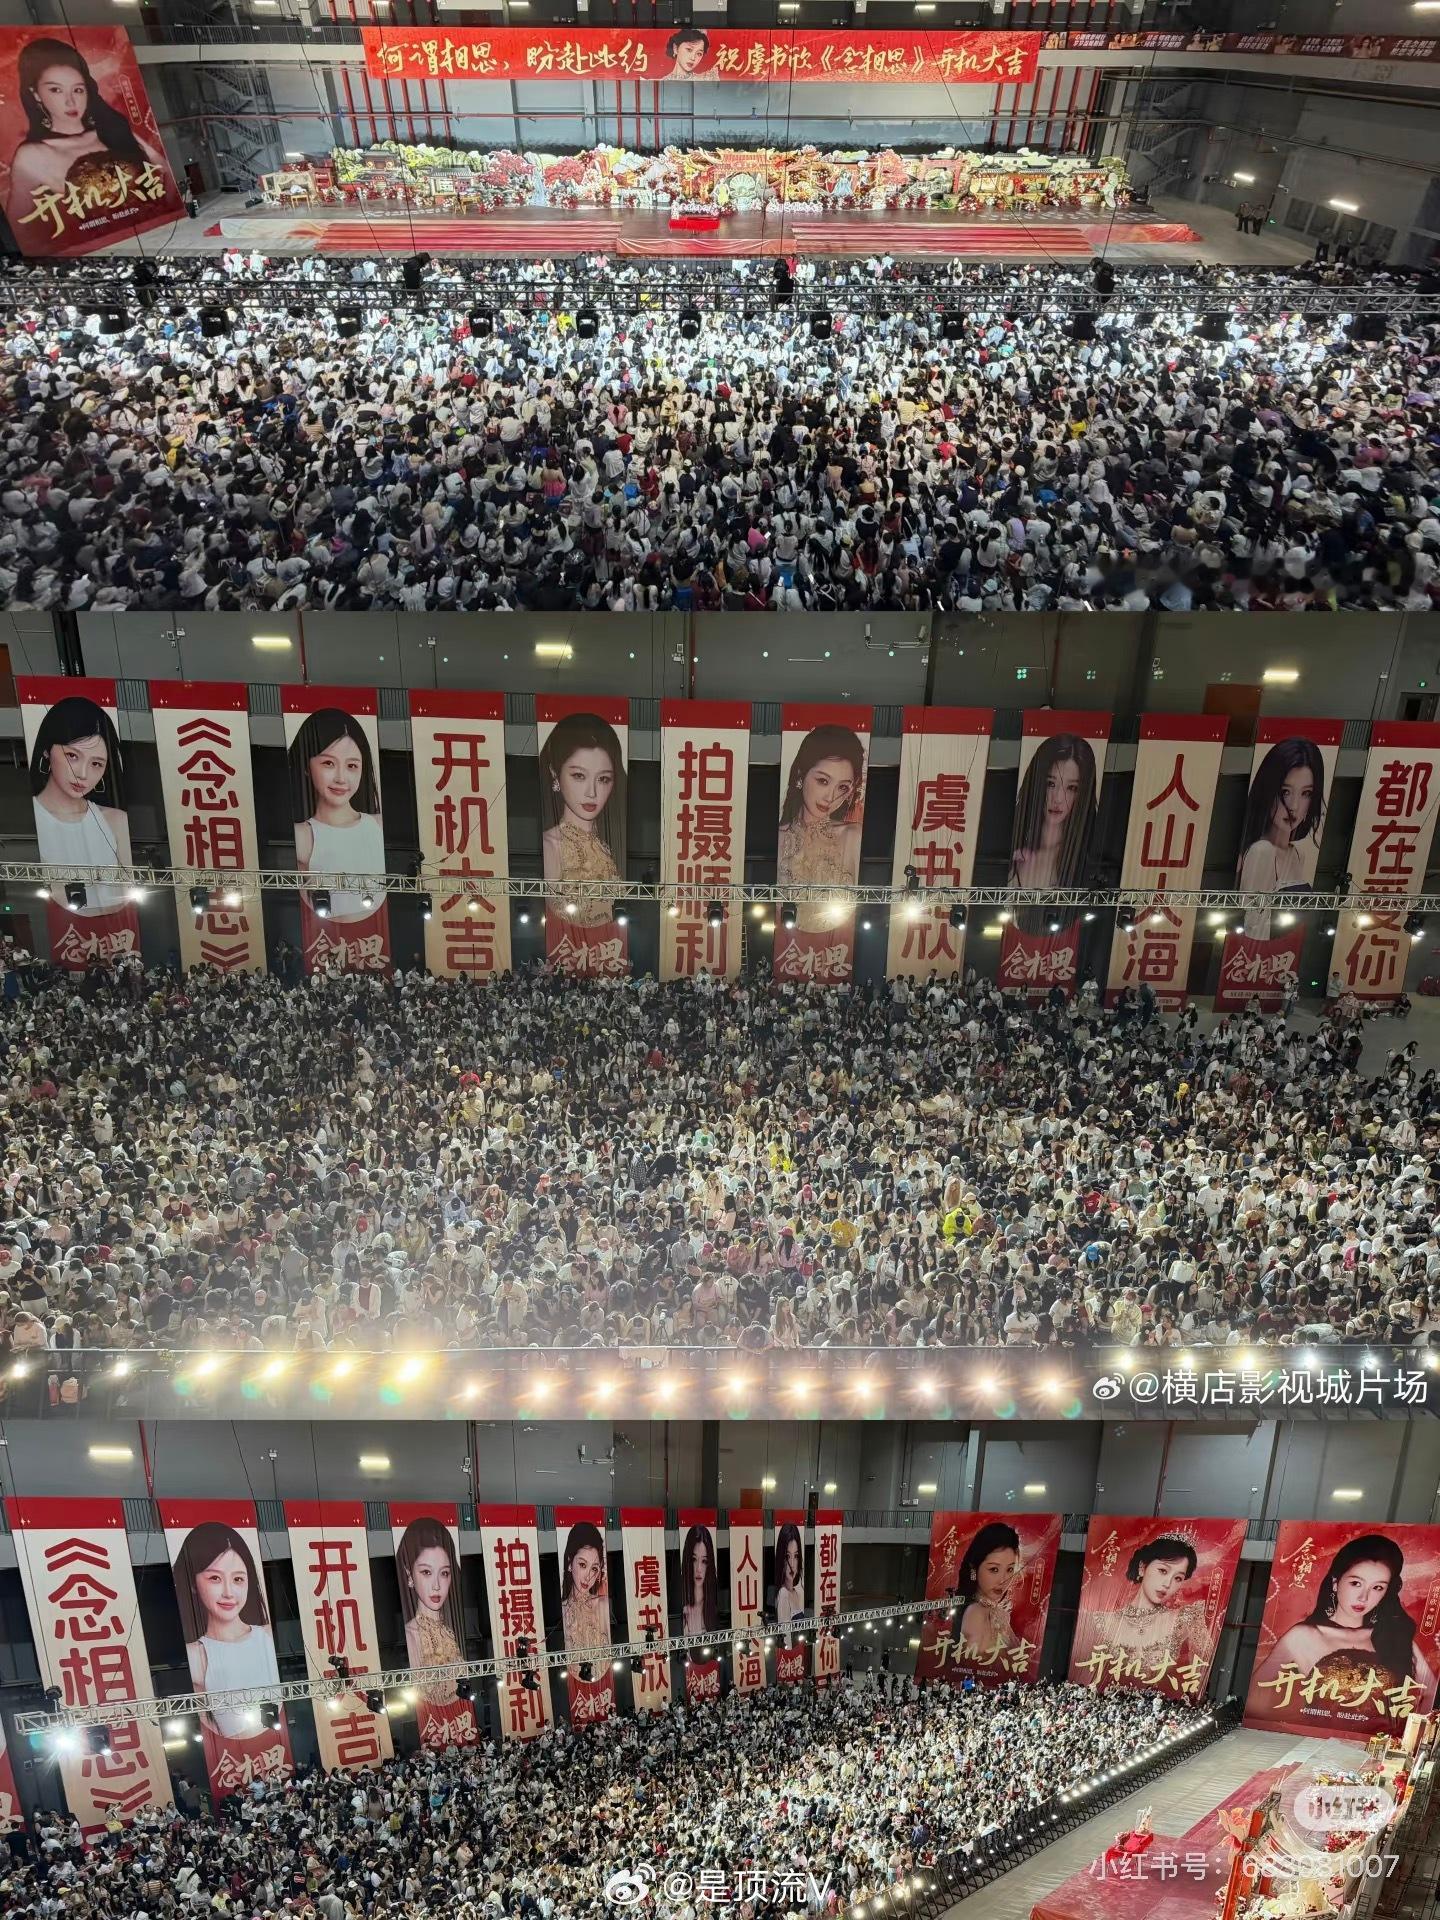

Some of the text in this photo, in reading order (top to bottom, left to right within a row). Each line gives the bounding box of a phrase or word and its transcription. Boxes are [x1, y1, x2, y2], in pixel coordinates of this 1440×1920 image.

[18, 161, 166, 239] 开机大吉
[431, 732, 496, 971] 开机大吉
[675, 740, 734, 976] 拍摄顺利
[901, 773, 970, 961] 虞书欣
[1122, 753, 1200, 982] 人山人海
[1345, 759, 1433, 986] 都在爱你
[53, 923, 142, 965] 念相思
[305, 928, 390, 970] 念相思
[547, 933, 628, 973] 念相思
[775, 938, 853, 978] 念相思
[1000, 942, 1077, 981] 念相思
[1222, 945, 1299, 985] 念相思
[1091, 1530, 1121, 1577] 念相思
[1279, 1537, 1317, 1589] 念相思
[494, 1537, 545, 1733] 拍摄顺利
[634, 1555, 669, 1693] 虞书欣
[309, 1541, 378, 1766] 开机大吉
[923, 1630, 1036, 1673] 开机大吉
[1075, 1644, 1209, 1693] 开机大吉
[571, 1688, 616, 1719] 念相思
[1257, 1663, 1427, 1718] 开机大吉
[420, 1709, 478, 1747] 念相思
[210, 1744, 294, 1788] 念相思
